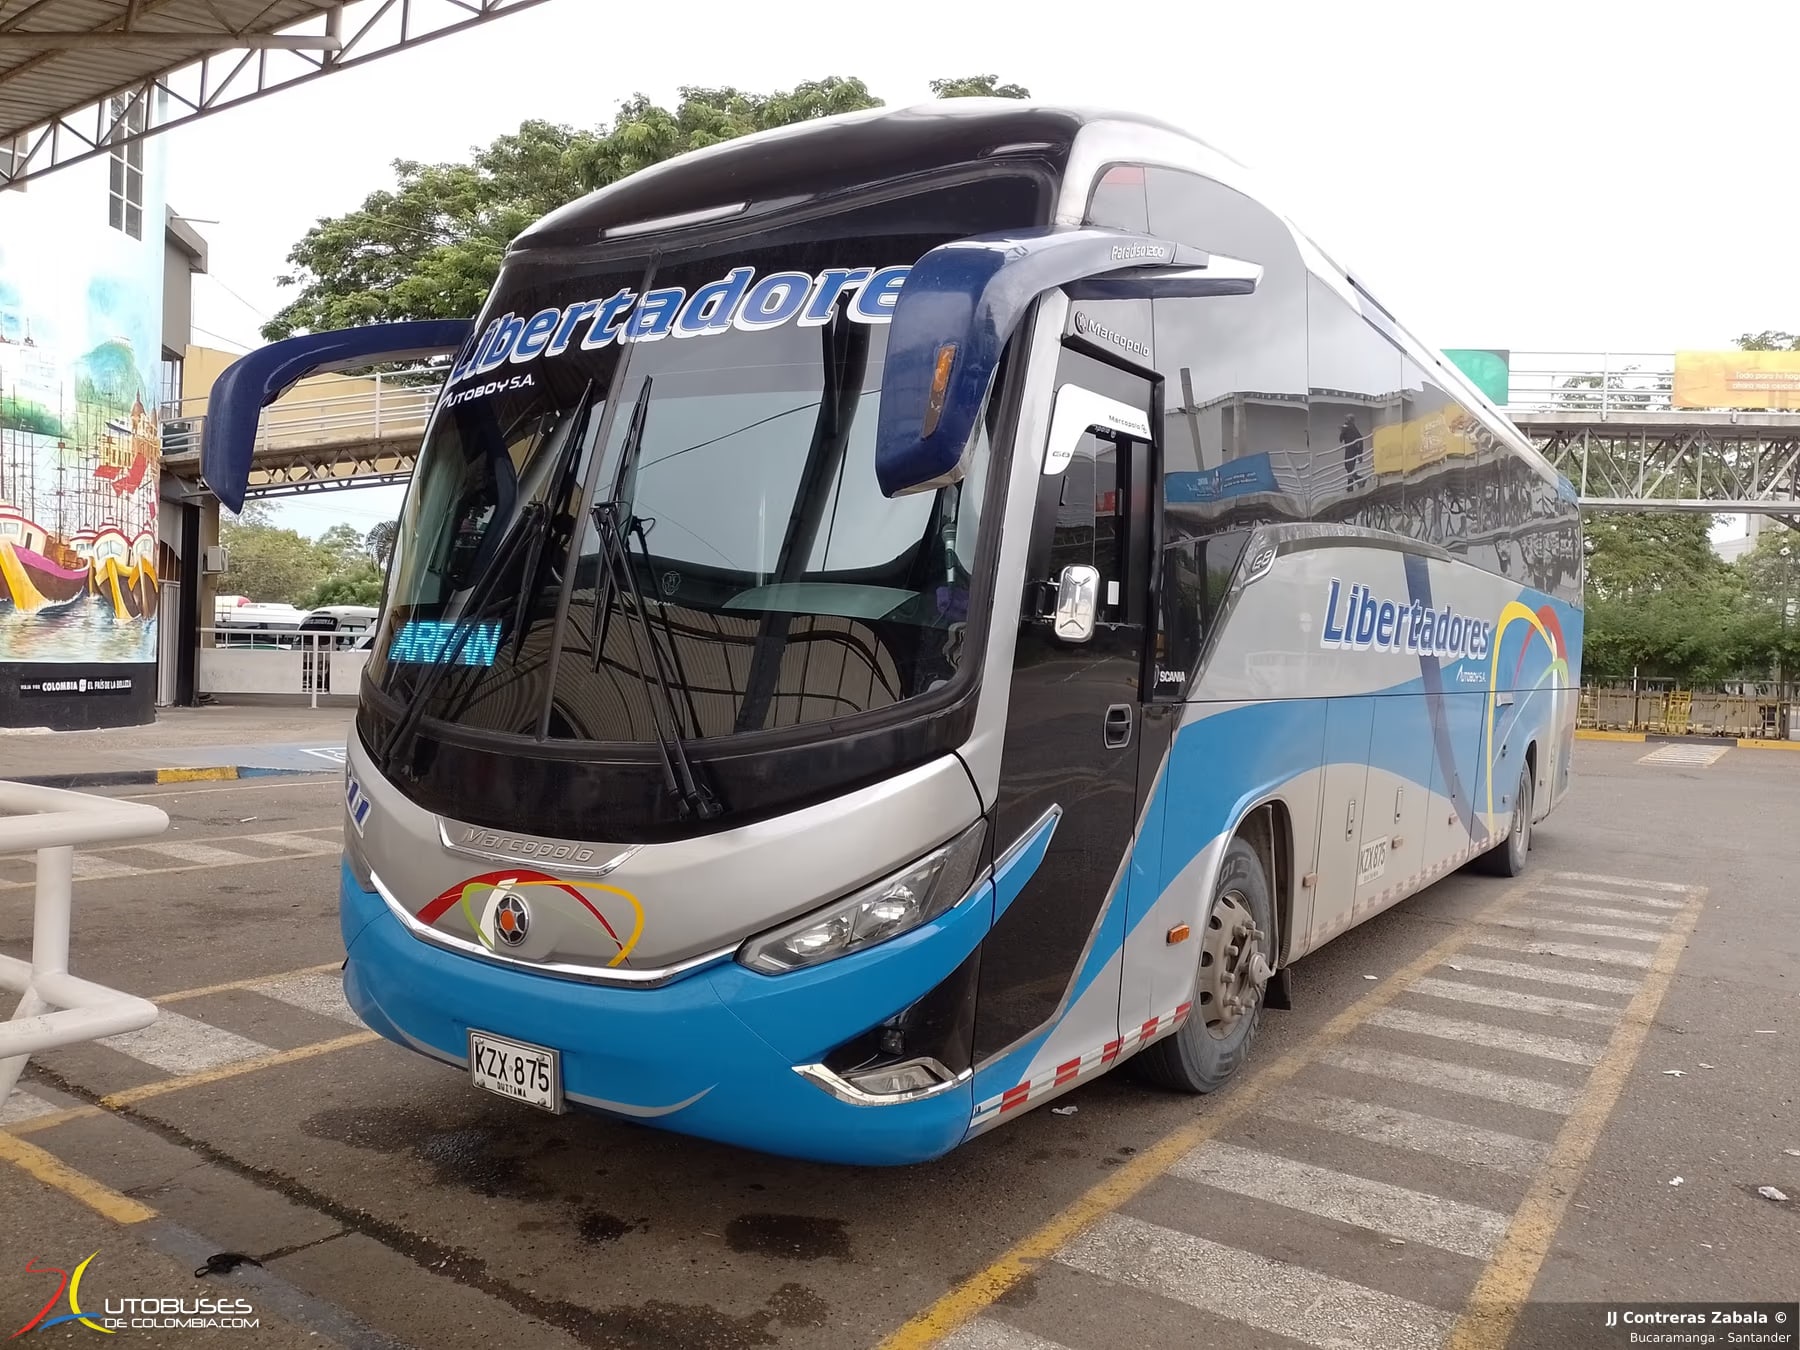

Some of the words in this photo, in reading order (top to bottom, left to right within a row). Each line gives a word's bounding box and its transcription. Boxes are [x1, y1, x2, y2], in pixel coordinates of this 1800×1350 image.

[447, 264, 914, 391] Libertadore
[1087, 319, 1150, 357] Marcopolo
[1108, 415, 1141, 430] Marcopolo
[1252, 549, 1273, 571] G8
[1320, 577, 1490, 660] Libertadores
[42, 681, 78, 692] COLOMBIA
[87, 681, 94, 690] EL
[1160, 670, 1186, 683] SCANIA
[461, 827, 595, 863] Marcopolo
